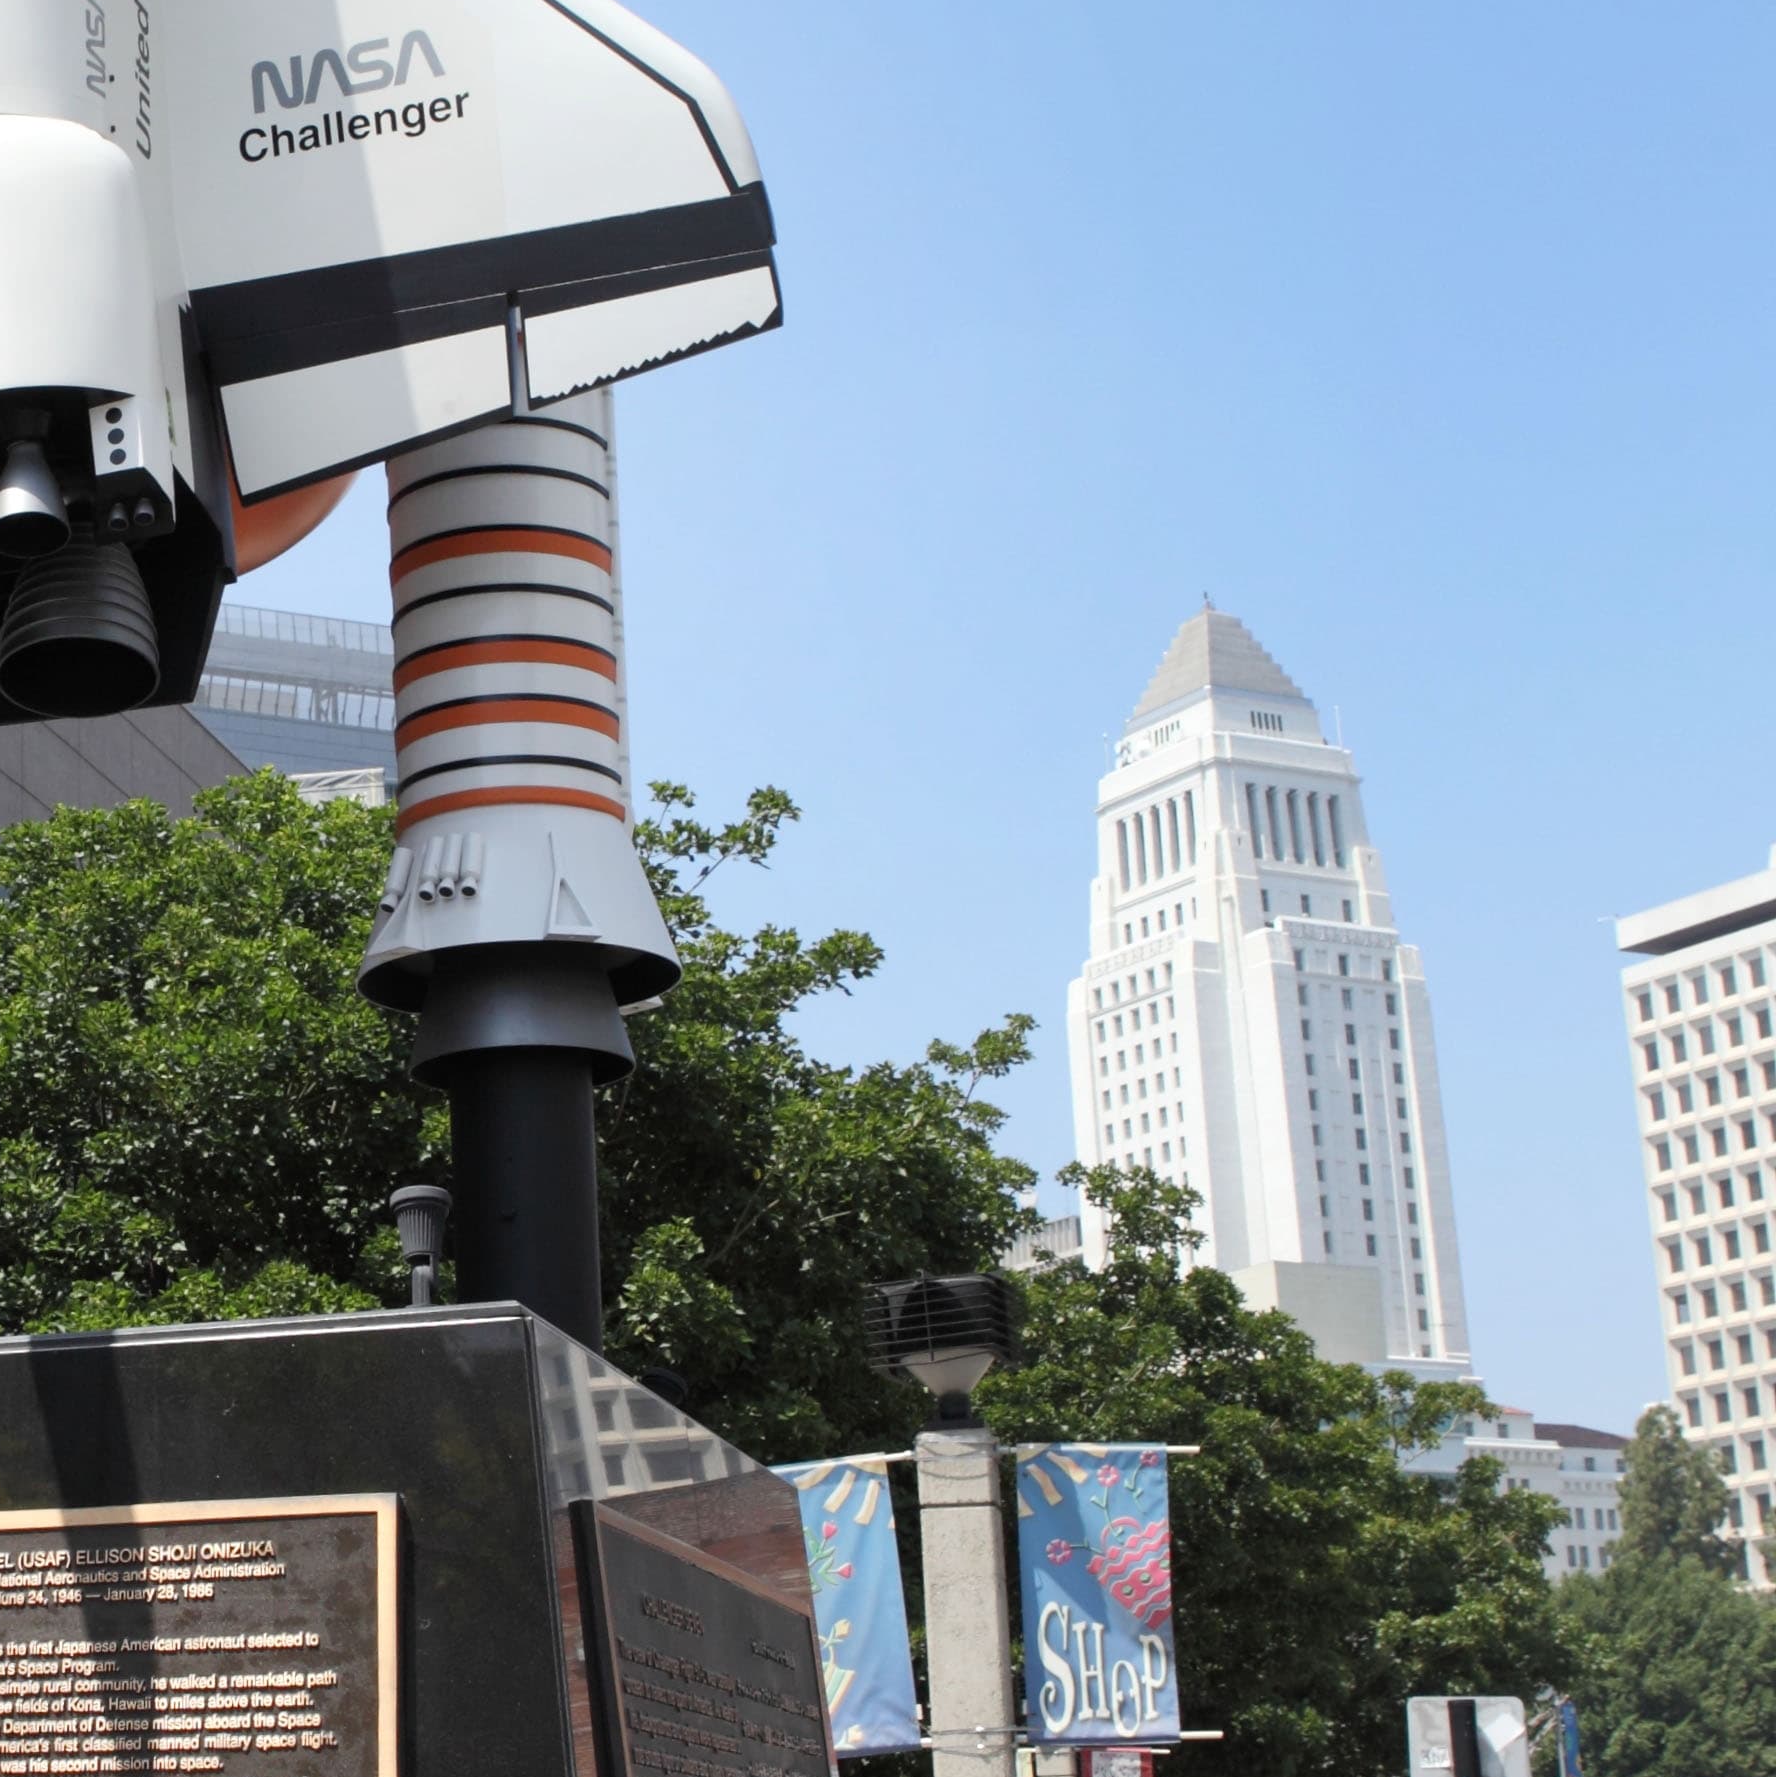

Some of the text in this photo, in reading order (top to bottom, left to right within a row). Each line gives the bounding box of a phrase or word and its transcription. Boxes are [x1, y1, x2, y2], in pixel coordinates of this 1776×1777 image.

[251, 29, 446, 114] NASA
[239, 91, 470, 162] Challenger
[18, 1549, 71, 1570] (USAF)
[76, 1548, 144, 1565] ELLISON
[147, 1544, 197, 1562] SHOJI
[200, 1541, 275, 1560] ONIZUKA
[44, 1568, 119, 1587] Aeronautics
[123, 1567, 147, 1582] and
[149, 1565, 191, 1583] Space
[194, 1561, 285, 1578] Administration
[27, 1590, 49, 1606] 24,
[52, 1589, 82, 1603] 1946
[103, 1586, 154, 1602] January
[156, 1584, 179, 1601] 28,
[182, 1582, 214, 1598] 1986
[6, 1641, 26, 1655] the
[29, 1640, 53, 1655] first
[54, 1639, 117, 1658] Japanese
[120, 1636, 181, 1652] American
[184, 1633, 245, 1650] astronaut
[247, 1631, 302, 1649] selected
[18, 1660, 59, 1678] Space
[61, 1658, 120, 1676] Program.
[1037, 1600, 1168, 1737] SHOP
[0, 1680, 40, 1697] simple
[43, 1678, 72, 1693] rural
[75, 1677, 147, 1694] community,
[169, 1674, 216, 1690] walked
[230, 1671, 304, 1688] remarkable
[307, 1670, 337, 1687] path
[15, 1698, 49, 1713] fields
[67, 1697, 105, 1713] Kona,
[108, 1696, 151, 1711] Hawaii
[170, 1694, 205, 1710] miles
[207, 1693, 248, 1709] above
[251, 1692, 272, 1708] the
[275, 1690, 314, 1707] earth.
[3, 1718, 77, 1735] Department
[95, 1716, 148, 1731] Defense
[152, 1714, 202, 1730] mission
[204, 1714, 251, 1730] aboard
[253, 1712, 275, 1728] the
[277, 1711, 321, 1729] Space
[54, 1737, 78, 1752] first
[82, 1735, 142, 1753] classified
[147, 1734, 200, 1750] manned
[204, 1733, 252, 1751] military
[255, 1734, 296, 1751] space
[300, 1731, 338, 1749] flight.
[0, 1761, 27, 1773] was
[29, 1758, 49, 1773] his
[51, 1756, 98, 1772] second
[100, 1755, 149, 1771] mission
[152, 1755, 177, 1770] into
[179, 1756, 224, 1772] space.
